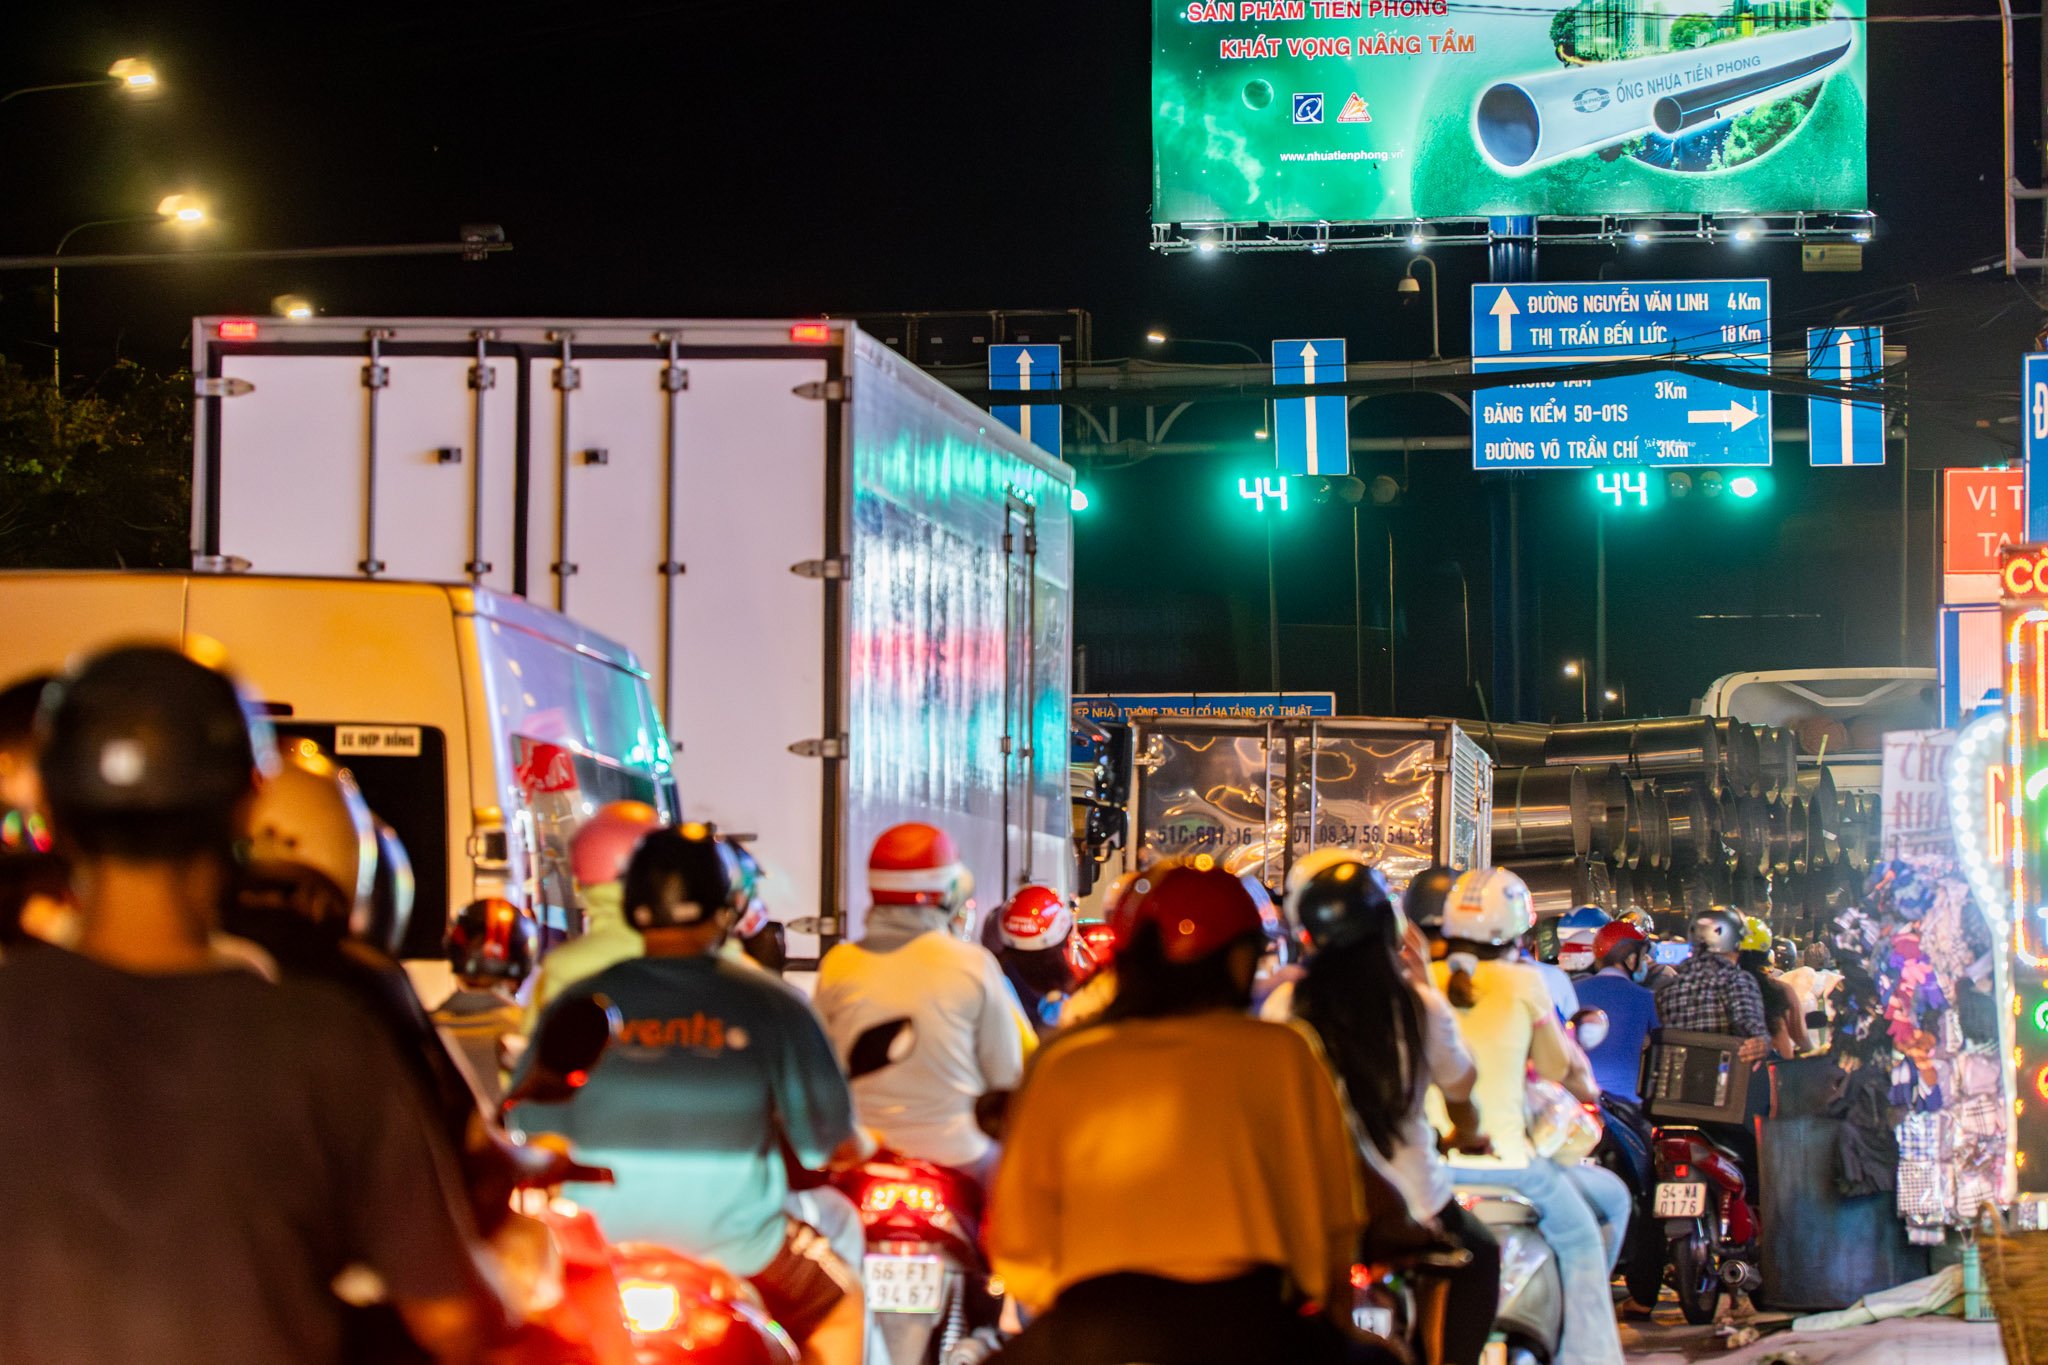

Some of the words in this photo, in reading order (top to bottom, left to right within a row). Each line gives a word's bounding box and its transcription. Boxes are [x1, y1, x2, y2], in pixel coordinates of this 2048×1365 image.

[1221, 34, 1281, 58] KHÁT
[1287, 37, 1350, 60] VỌNG
[1358, 32, 1421, 56] NÂNG
[1616, 79, 1643, 103] ỐNG
[1647, 73, 1682, 95] NHỰA
[1716, 55, 1761, 76] PHONG
[1280, 149, 1404, 162] www.nhuatienphong.vn
[1527, 290, 1578, 313] ĐƯỜNG
[1583, 287, 1639, 313] NGUYỄN
[1644, 290, 1672, 312] VĂN
[1676, 293, 1709, 311] LINH
[1529, 328, 1553, 349] THỊ
[1559, 320, 1599, 345] TRẤN
[1604, 320, 1633, 344] BẾN
[1640, 321, 1668, 344] LỨC
[1654, 381, 1687, 399] 3Km
[1483, 402, 1523, 424] ĐĂNG
[1530, 397, 1567, 423] KIỂM
[1574, 404, 1628, 422] 50-01S
[1485, 437, 1535, 460] ĐƯỜNG
[1540, 438, 1560, 459] VÕ
[1567, 434, 1608, 459] TRẦN
[1613, 435, 1639, 459] CHÍ
[1238, 476, 1288, 512] 44
[1596, 471, 1648, 506] 44
[1967, 486, 1998, 517] VỊ
[1660, 1200, 1697, 1215] 0176
